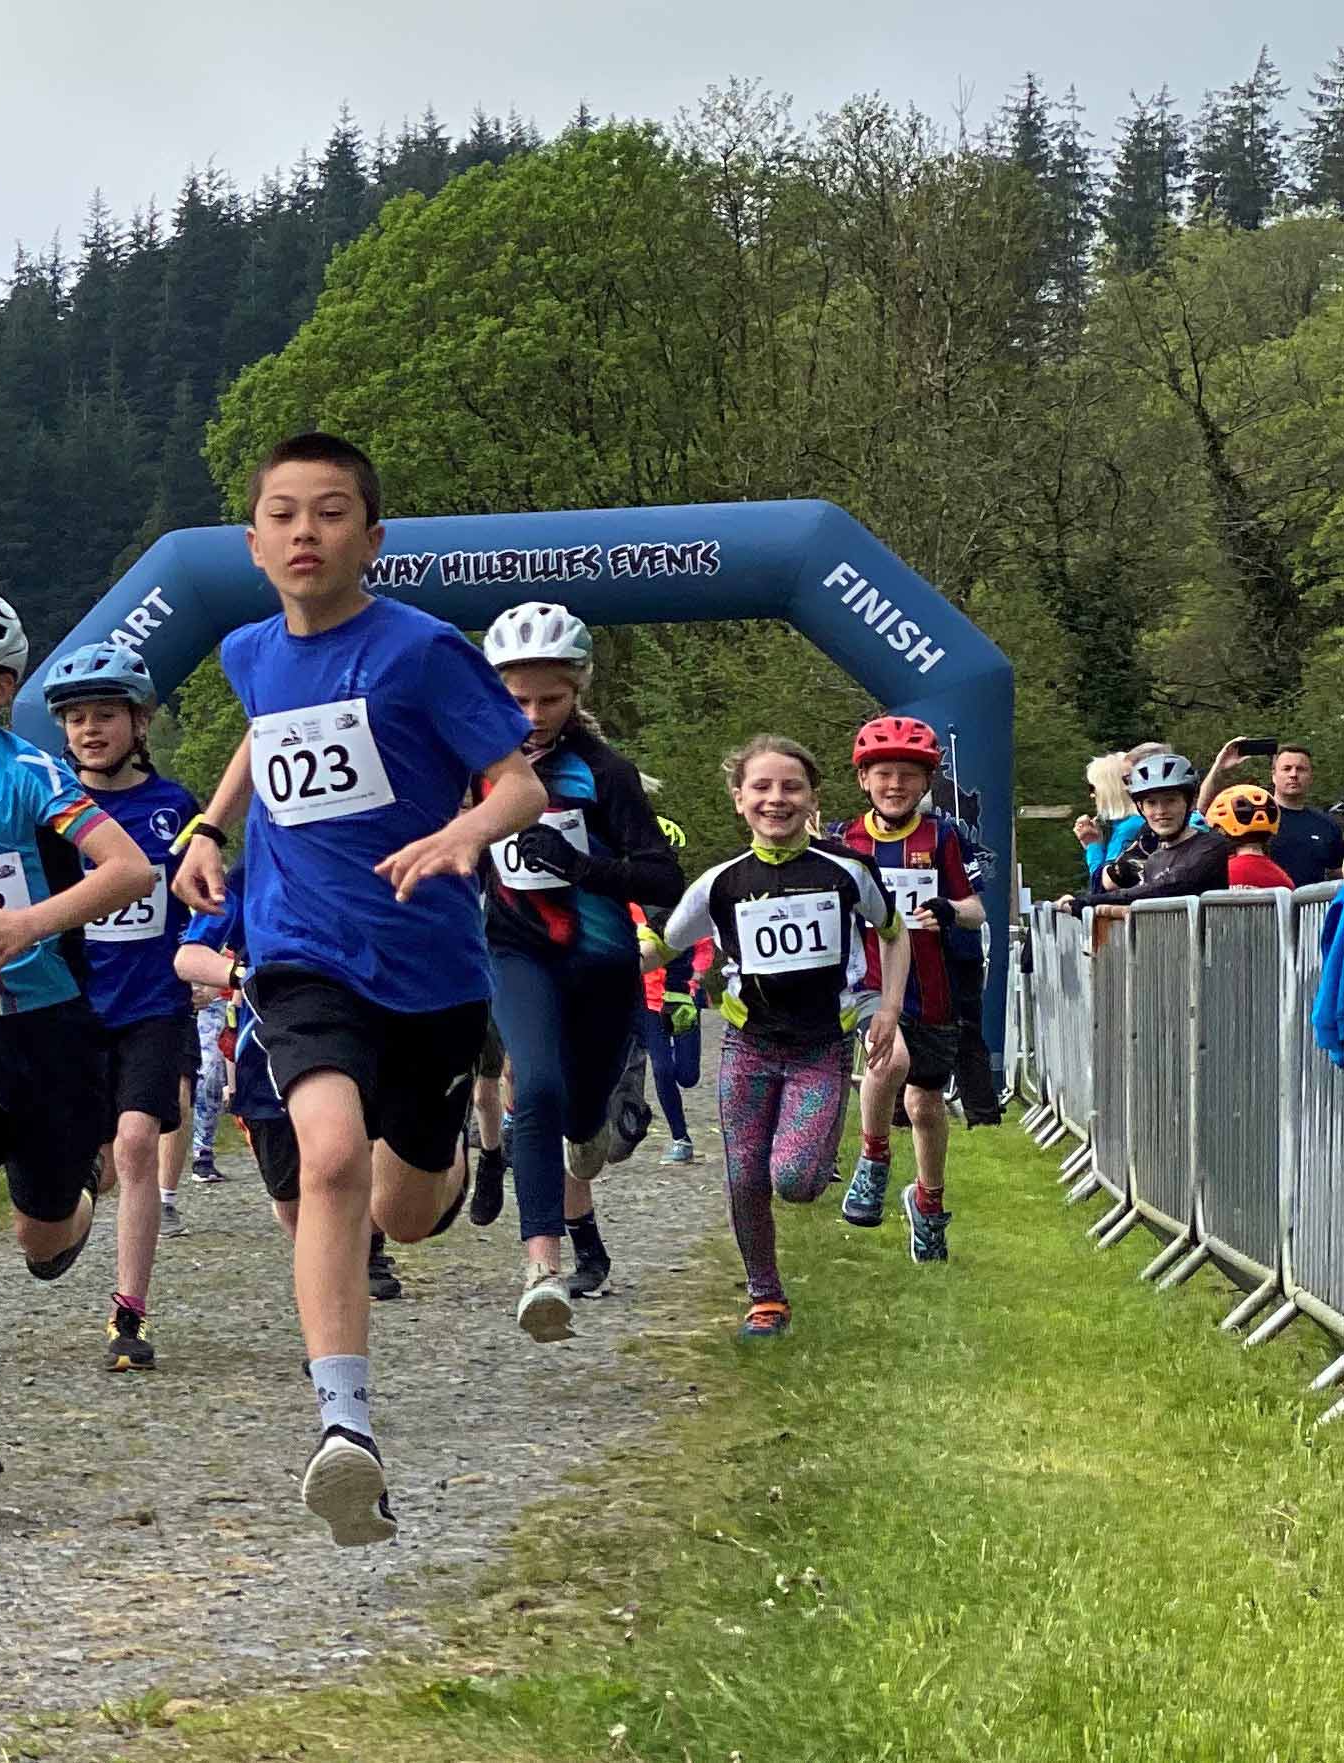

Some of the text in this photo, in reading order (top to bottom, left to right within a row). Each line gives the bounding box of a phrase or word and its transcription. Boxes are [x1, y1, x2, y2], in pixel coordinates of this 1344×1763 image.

[362, 540, 721, 588] WAY HILLBILLIES EVENTS
[110, 586, 174, 647] ART
[822, 561, 946, 675] FINISH
[268, 744, 359, 803] 023
[755, 919, 828, 958] 001
